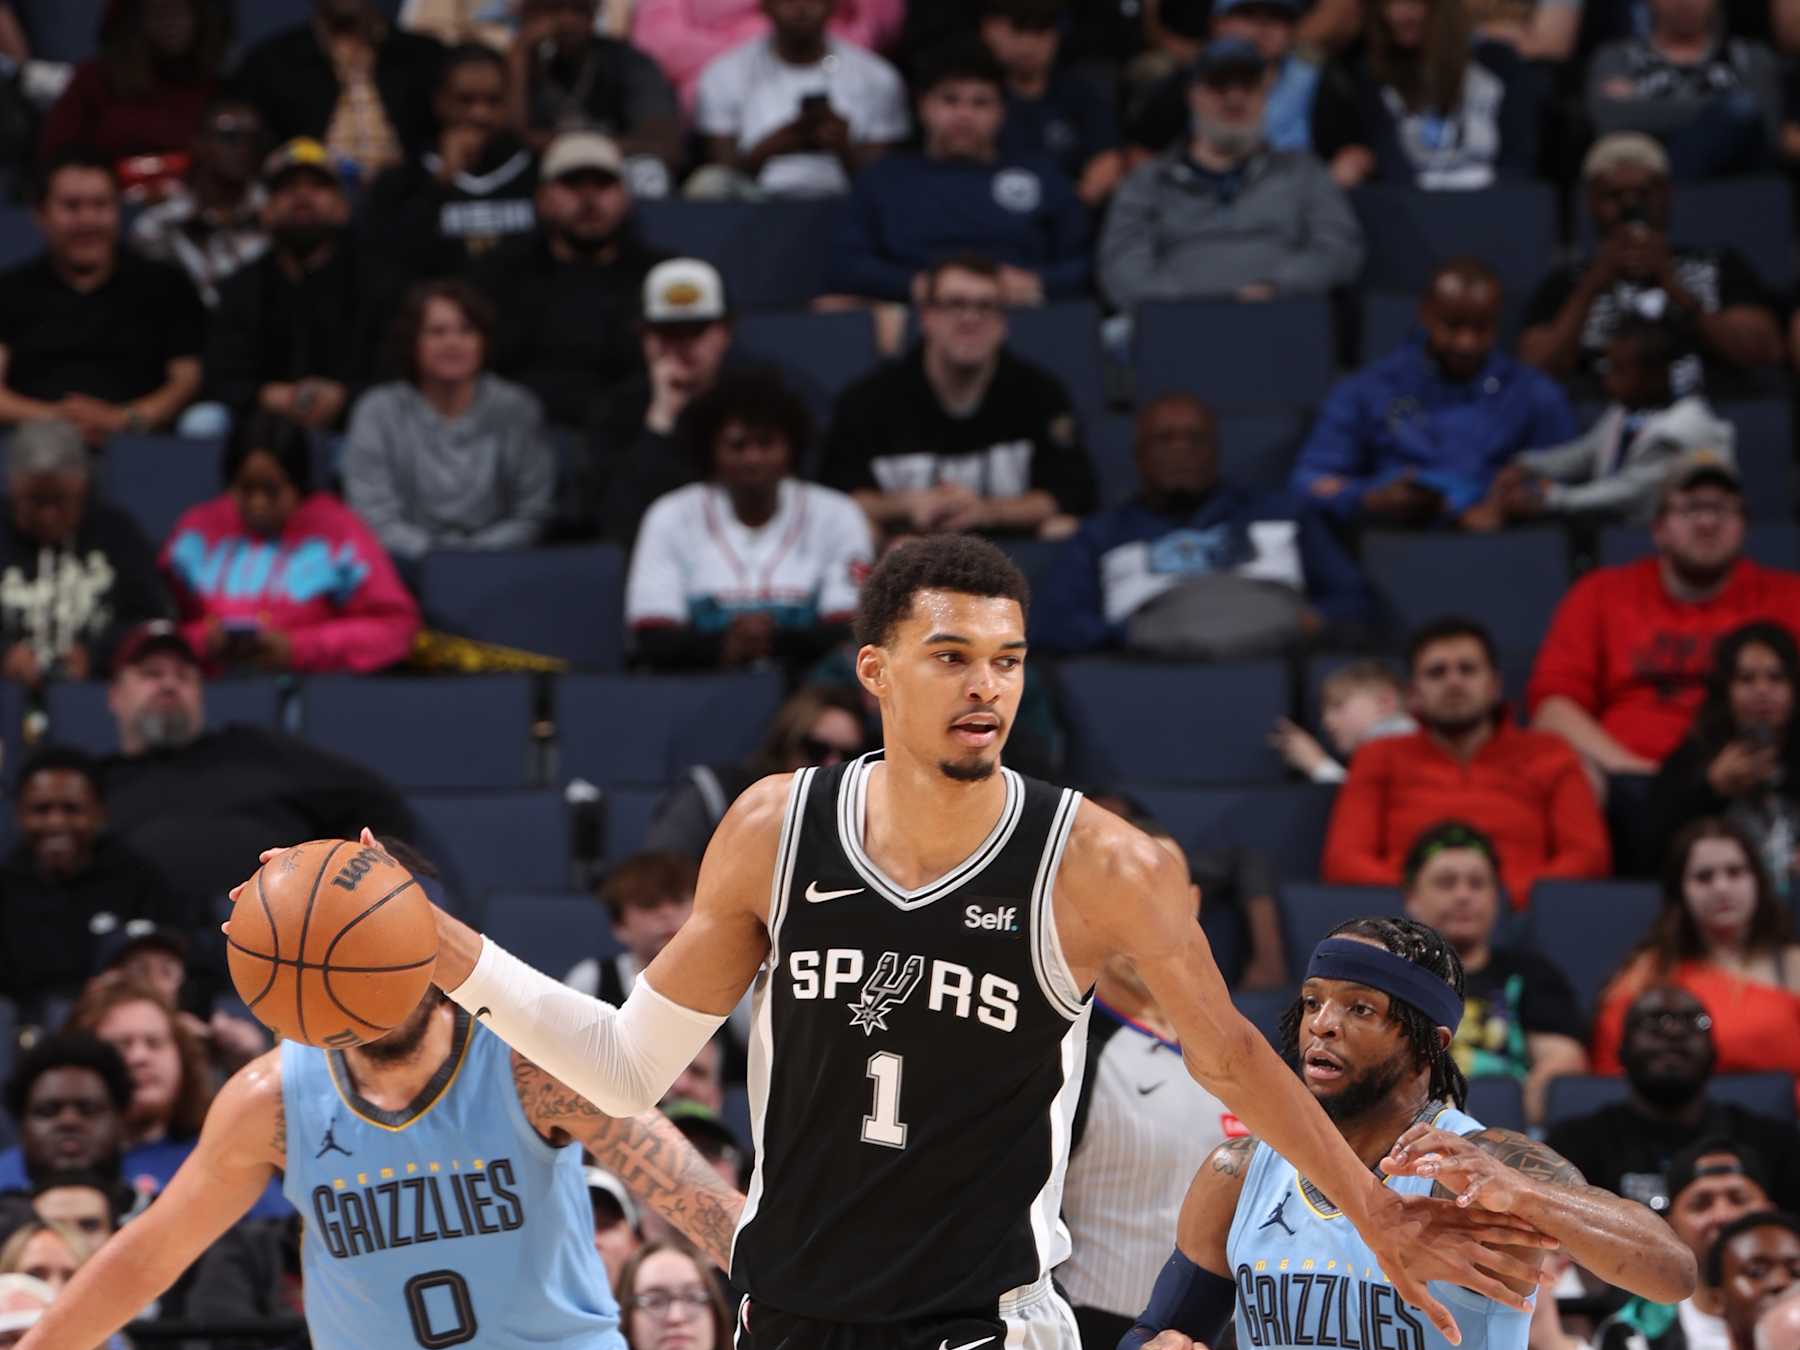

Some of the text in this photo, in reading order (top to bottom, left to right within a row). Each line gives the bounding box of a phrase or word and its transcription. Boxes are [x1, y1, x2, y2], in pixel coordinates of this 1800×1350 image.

[789, 948, 1020, 1036] SPURS
[860, 1050, 908, 1150] 1
[312, 1158, 525, 1259] GRIZZLIES
[333, 1158, 486, 1191] MEMPHIS
[403, 1269, 478, 1350] 0
